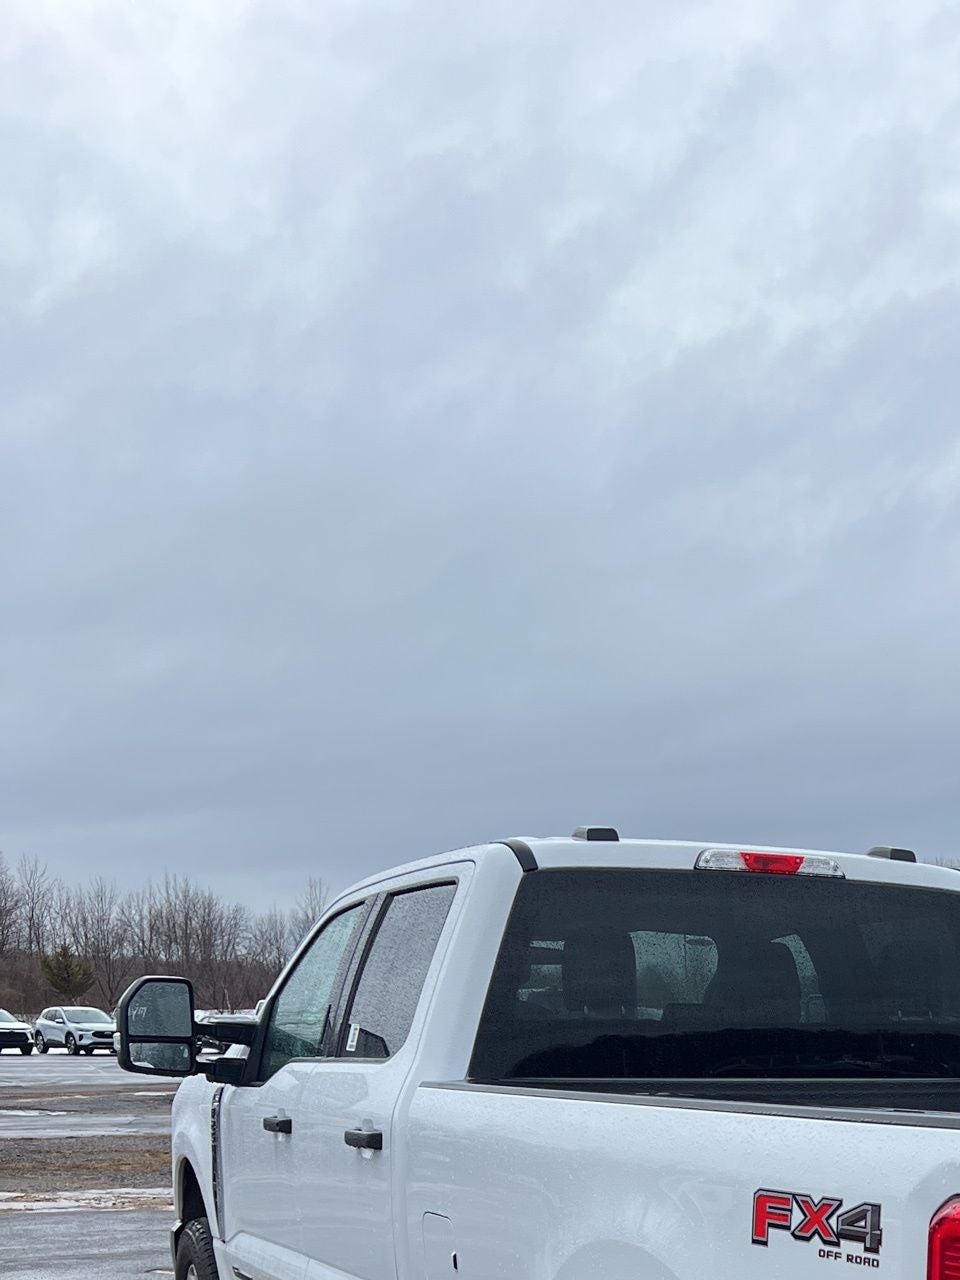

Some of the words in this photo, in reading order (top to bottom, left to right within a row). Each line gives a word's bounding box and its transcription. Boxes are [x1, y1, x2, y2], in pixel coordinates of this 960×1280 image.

[752, 1188, 882, 1255] FX4
[818, 1248, 842, 1261] OFF
[846, 1253, 880, 1268] ROAD
